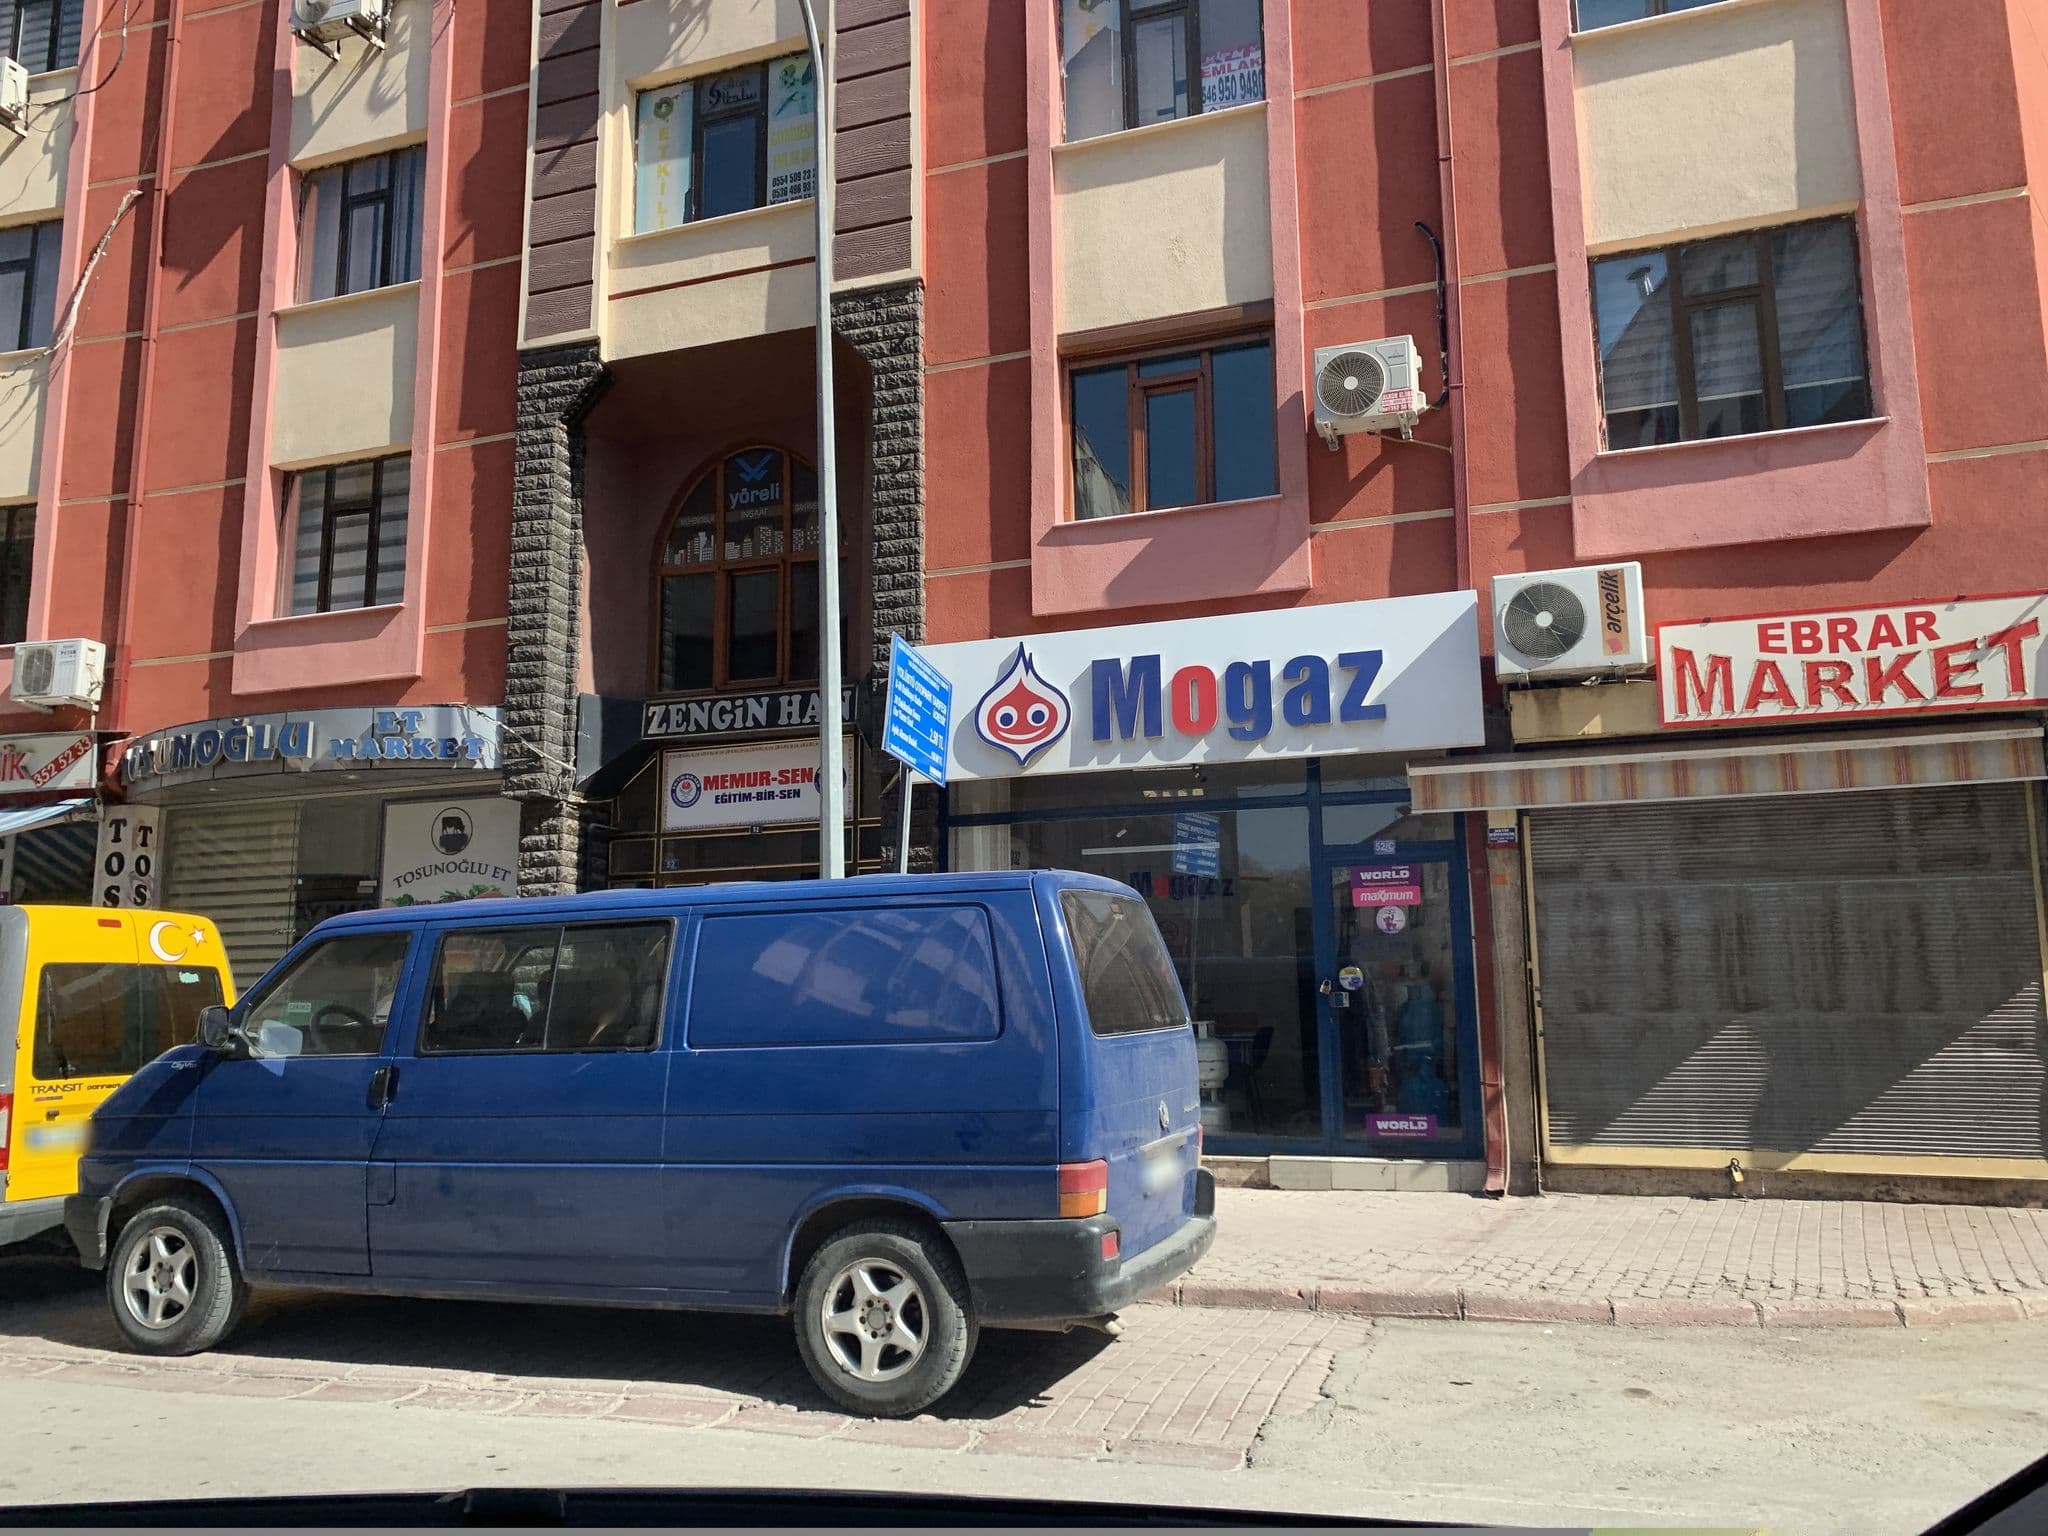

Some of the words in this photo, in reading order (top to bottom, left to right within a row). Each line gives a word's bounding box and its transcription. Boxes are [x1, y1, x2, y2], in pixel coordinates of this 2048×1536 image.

[1218, 74, 1237, 101] 950
[729, 482, 780, 509] yöreli
[1599, 570, 1625, 634] arçelik
[1756, 610, 1941, 655] EBRAR
[1671, 616, 2040, 718] MARKET
[1091, 649, 1387, 742] Mogaz
[376, 710, 424, 734] ET
[328, 736, 486, 760] MARKET
[33, 763, 58, 789] 352
[58, 751, 76, 770] 52
[75, 736, 93, 756] 33
[702, 767, 815, 791] MEMUR-SEN
[714, 788, 801, 805] EĞİTİM-BİR-SEN
[392, 858, 490, 888] TOSUNOĞLU
[491, 864, 512, 883] ET
[1359, 869, 1410, 880] WORLD
[29, 1083, 84, 1095] TRANSIT
[1376, 1119, 1428, 1131] WORLD
